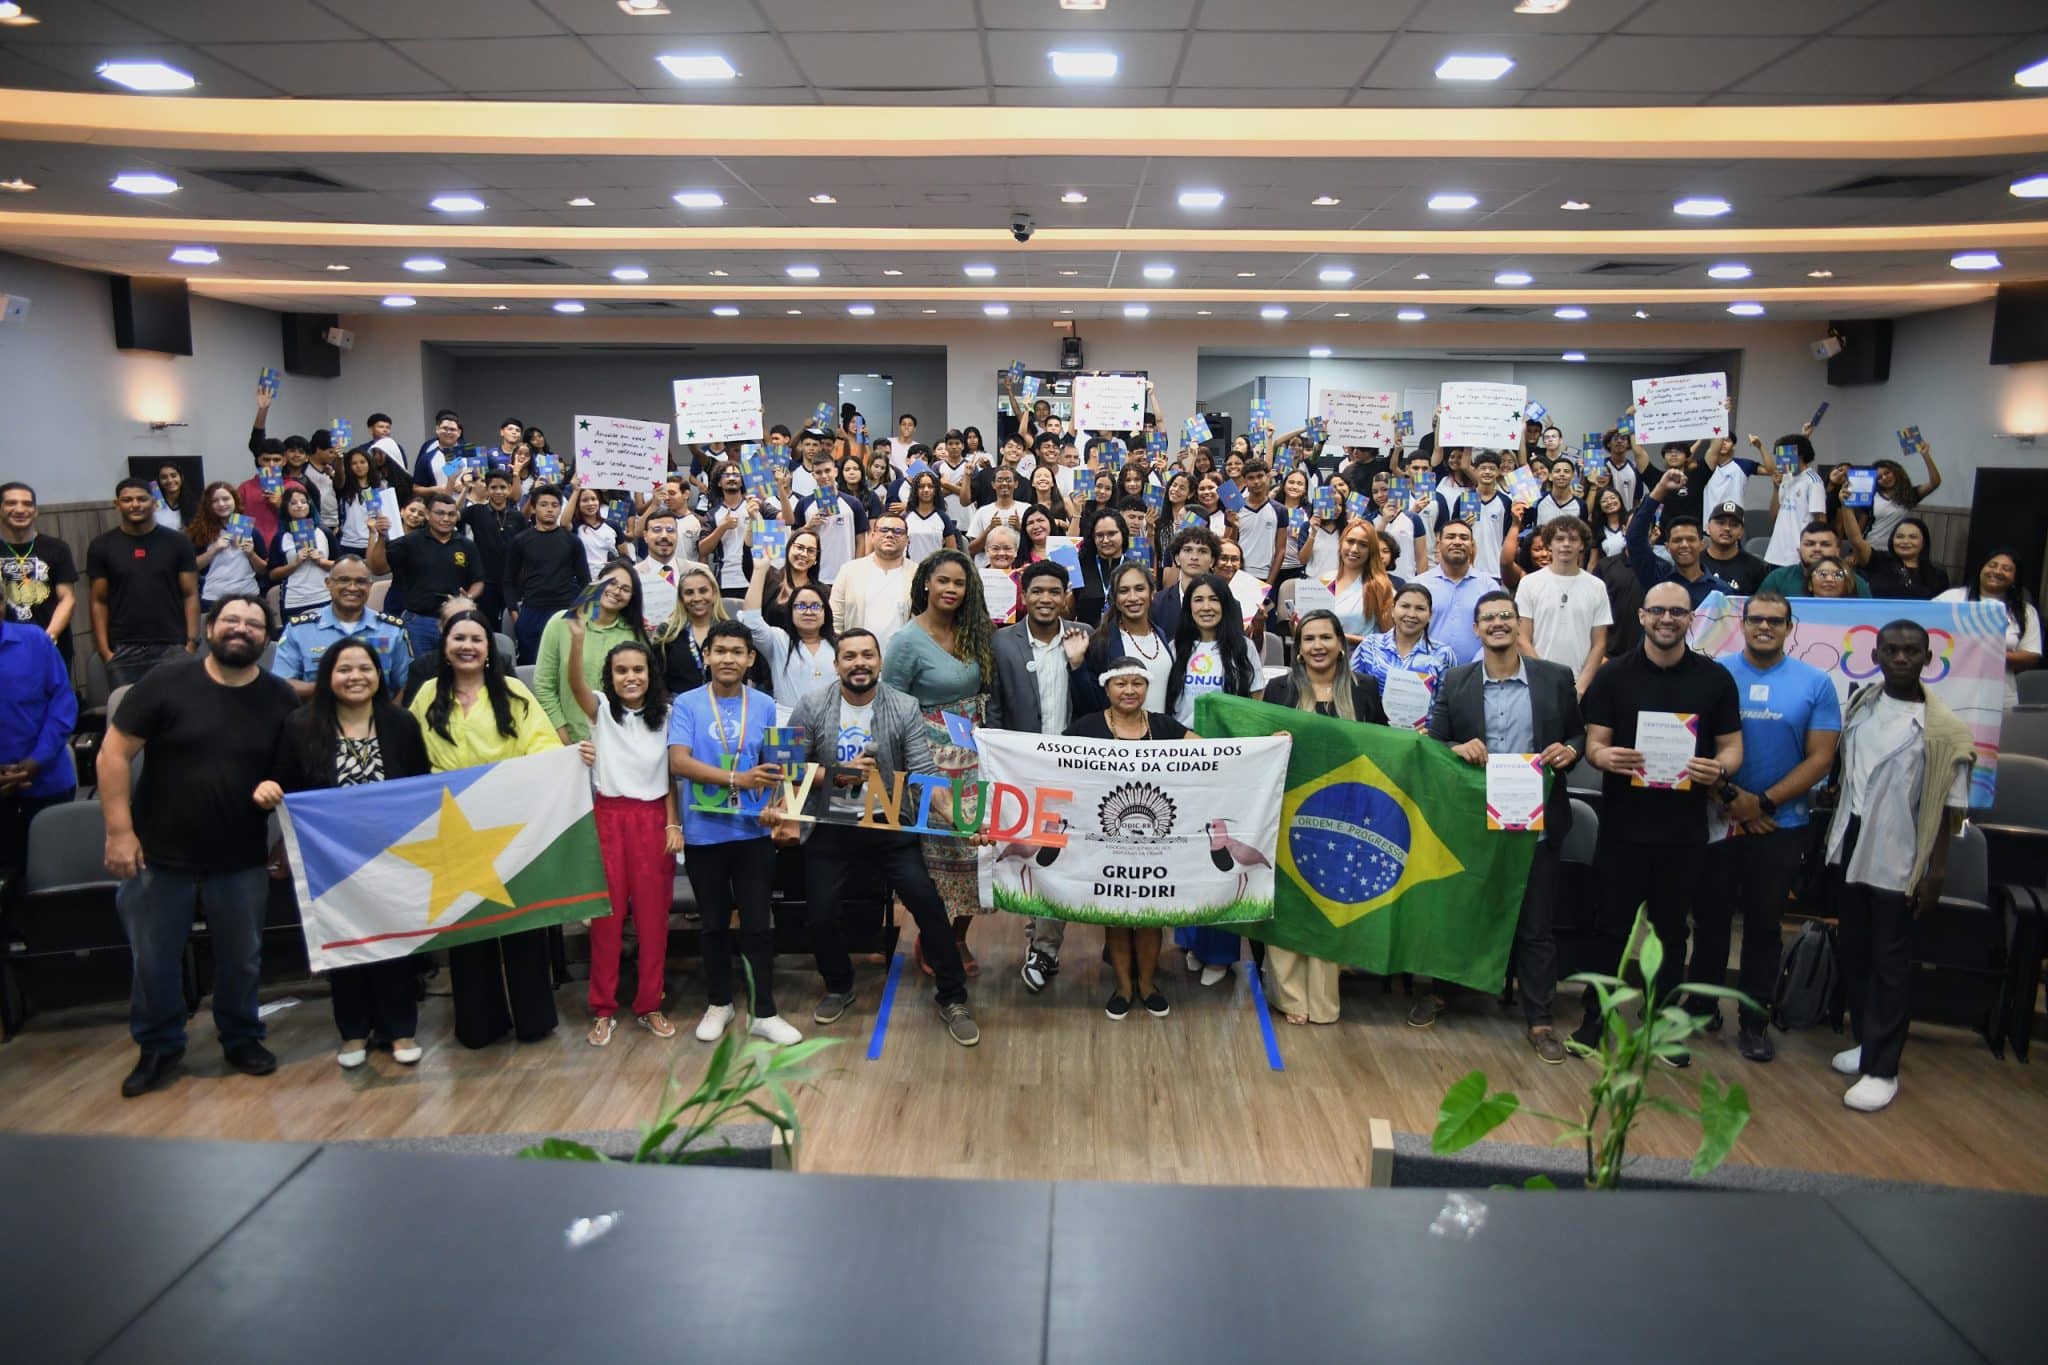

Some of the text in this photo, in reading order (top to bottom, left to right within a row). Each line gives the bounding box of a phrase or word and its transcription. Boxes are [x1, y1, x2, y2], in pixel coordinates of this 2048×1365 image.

[1184, 675, 1224, 686] ONJU
[1037, 741, 1243, 758] ASSOCIAÇÃO ESTADUAL DOS
[1058, 757, 1220, 773] INDÍGENAS DA CIDADE
[1298, 817, 1405, 861] ORDEM E PROGRESSO
[1102, 865, 1168, 880] GRUPO
[1093, 883, 1176, 899] DIRI-DIRI
